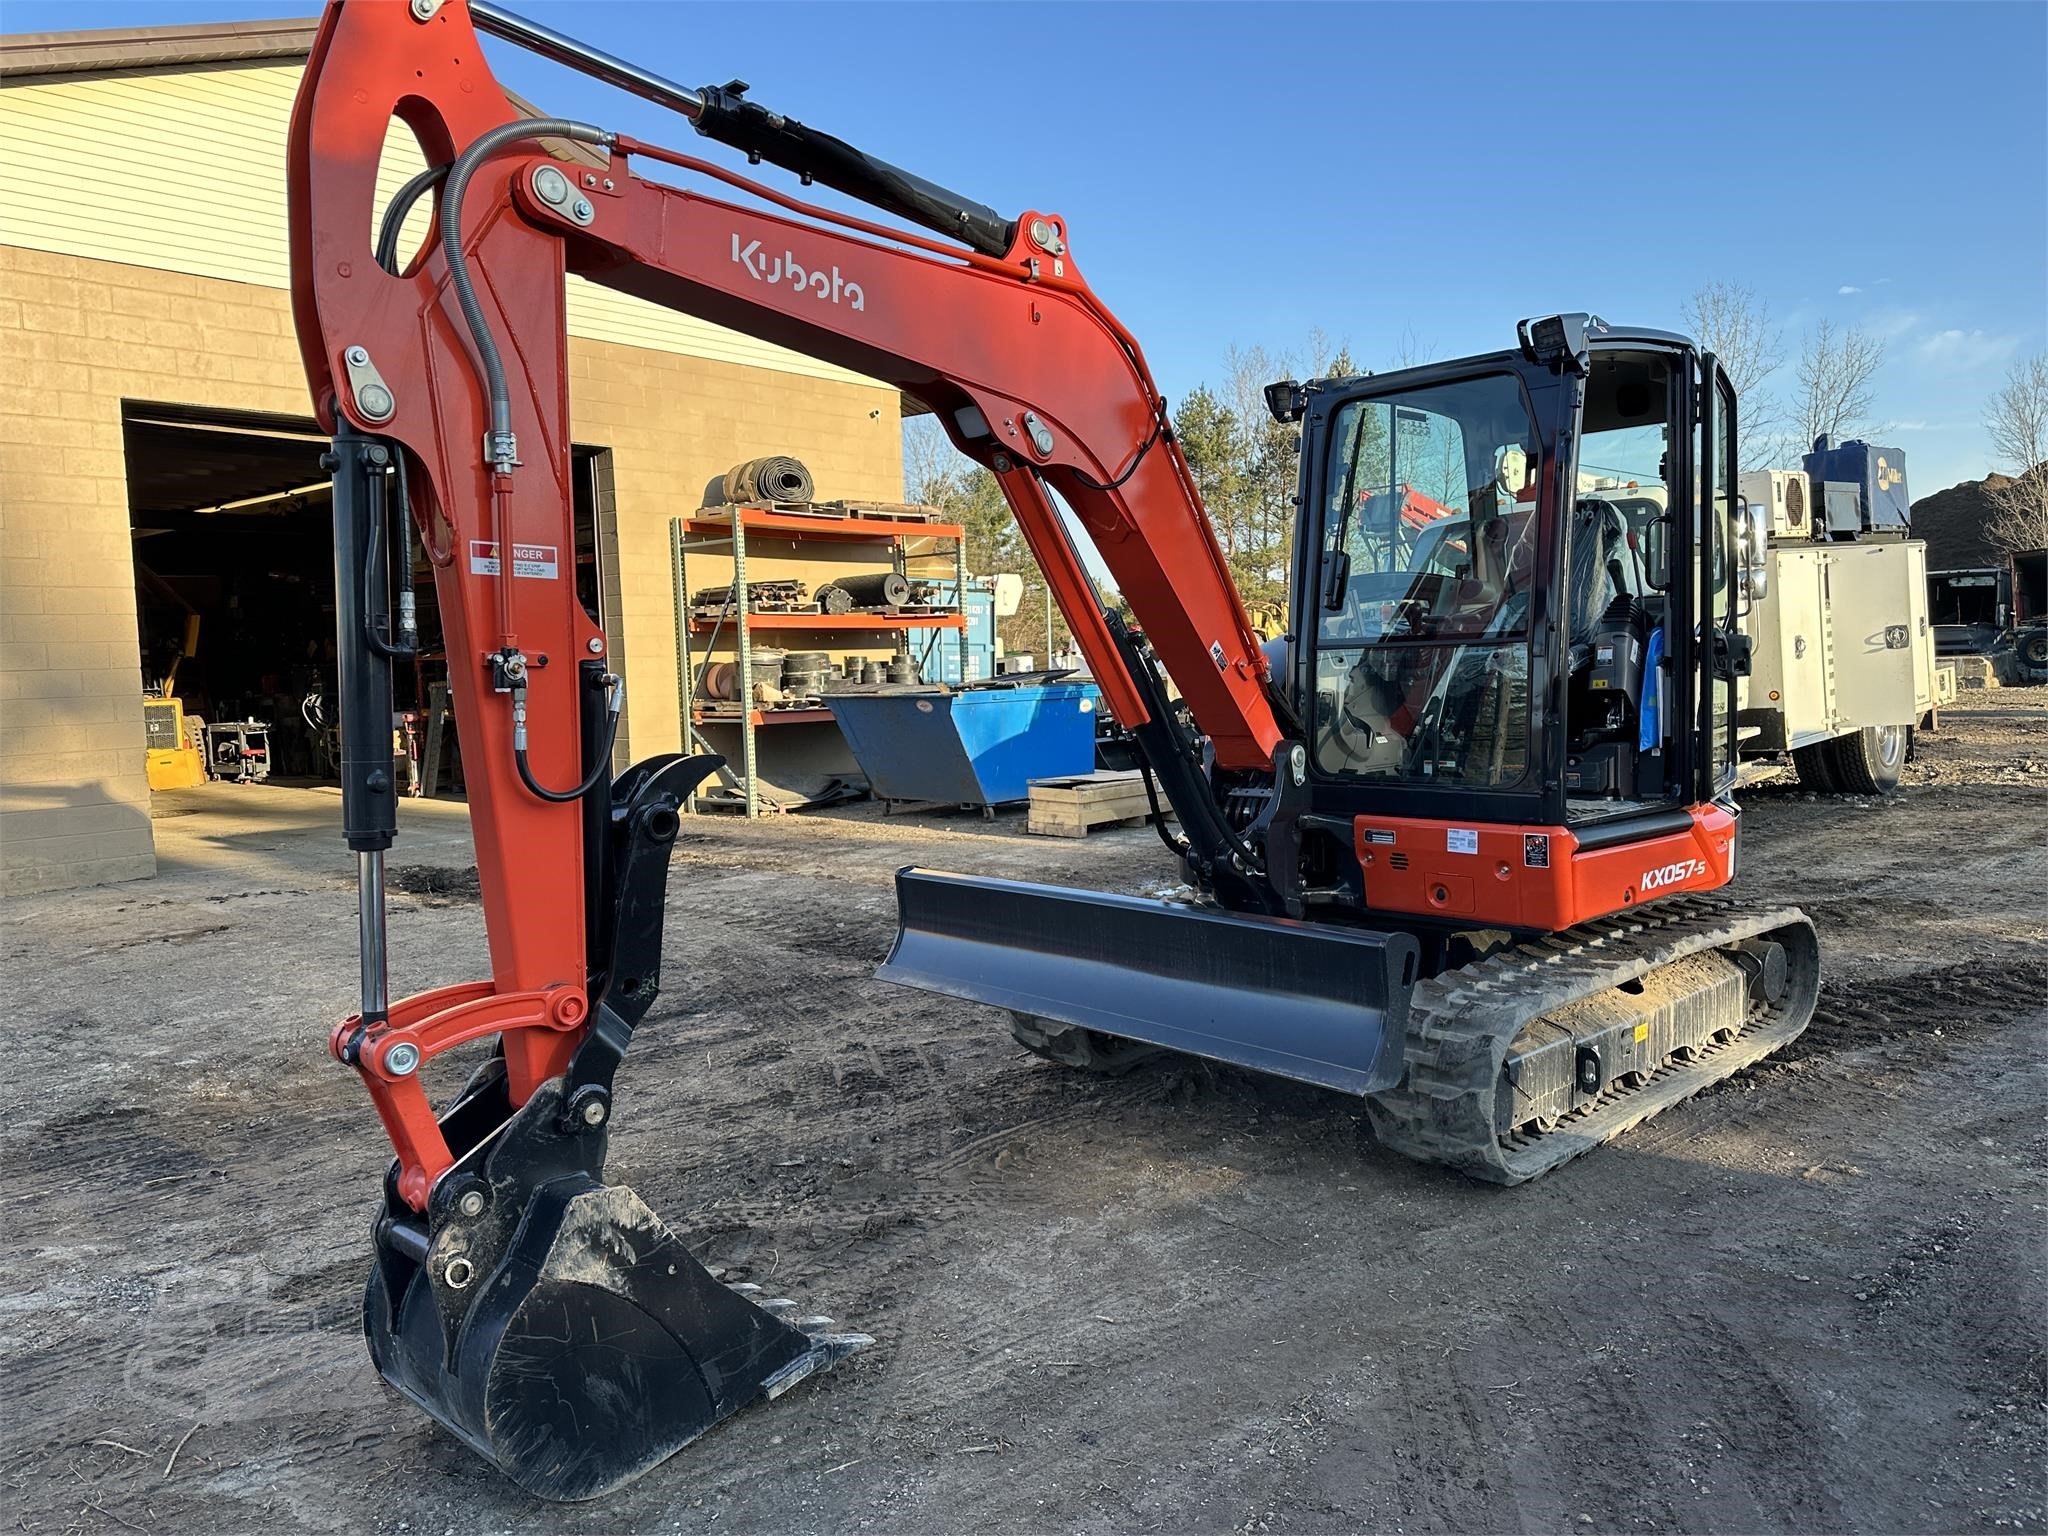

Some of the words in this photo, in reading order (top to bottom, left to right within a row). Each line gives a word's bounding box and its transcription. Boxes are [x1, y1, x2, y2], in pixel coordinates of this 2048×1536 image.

[732, 232, 864, 312] Kubota
[513, 548, 543, 560] NGER
[1640, 858, 1706, 892] KX057-5
